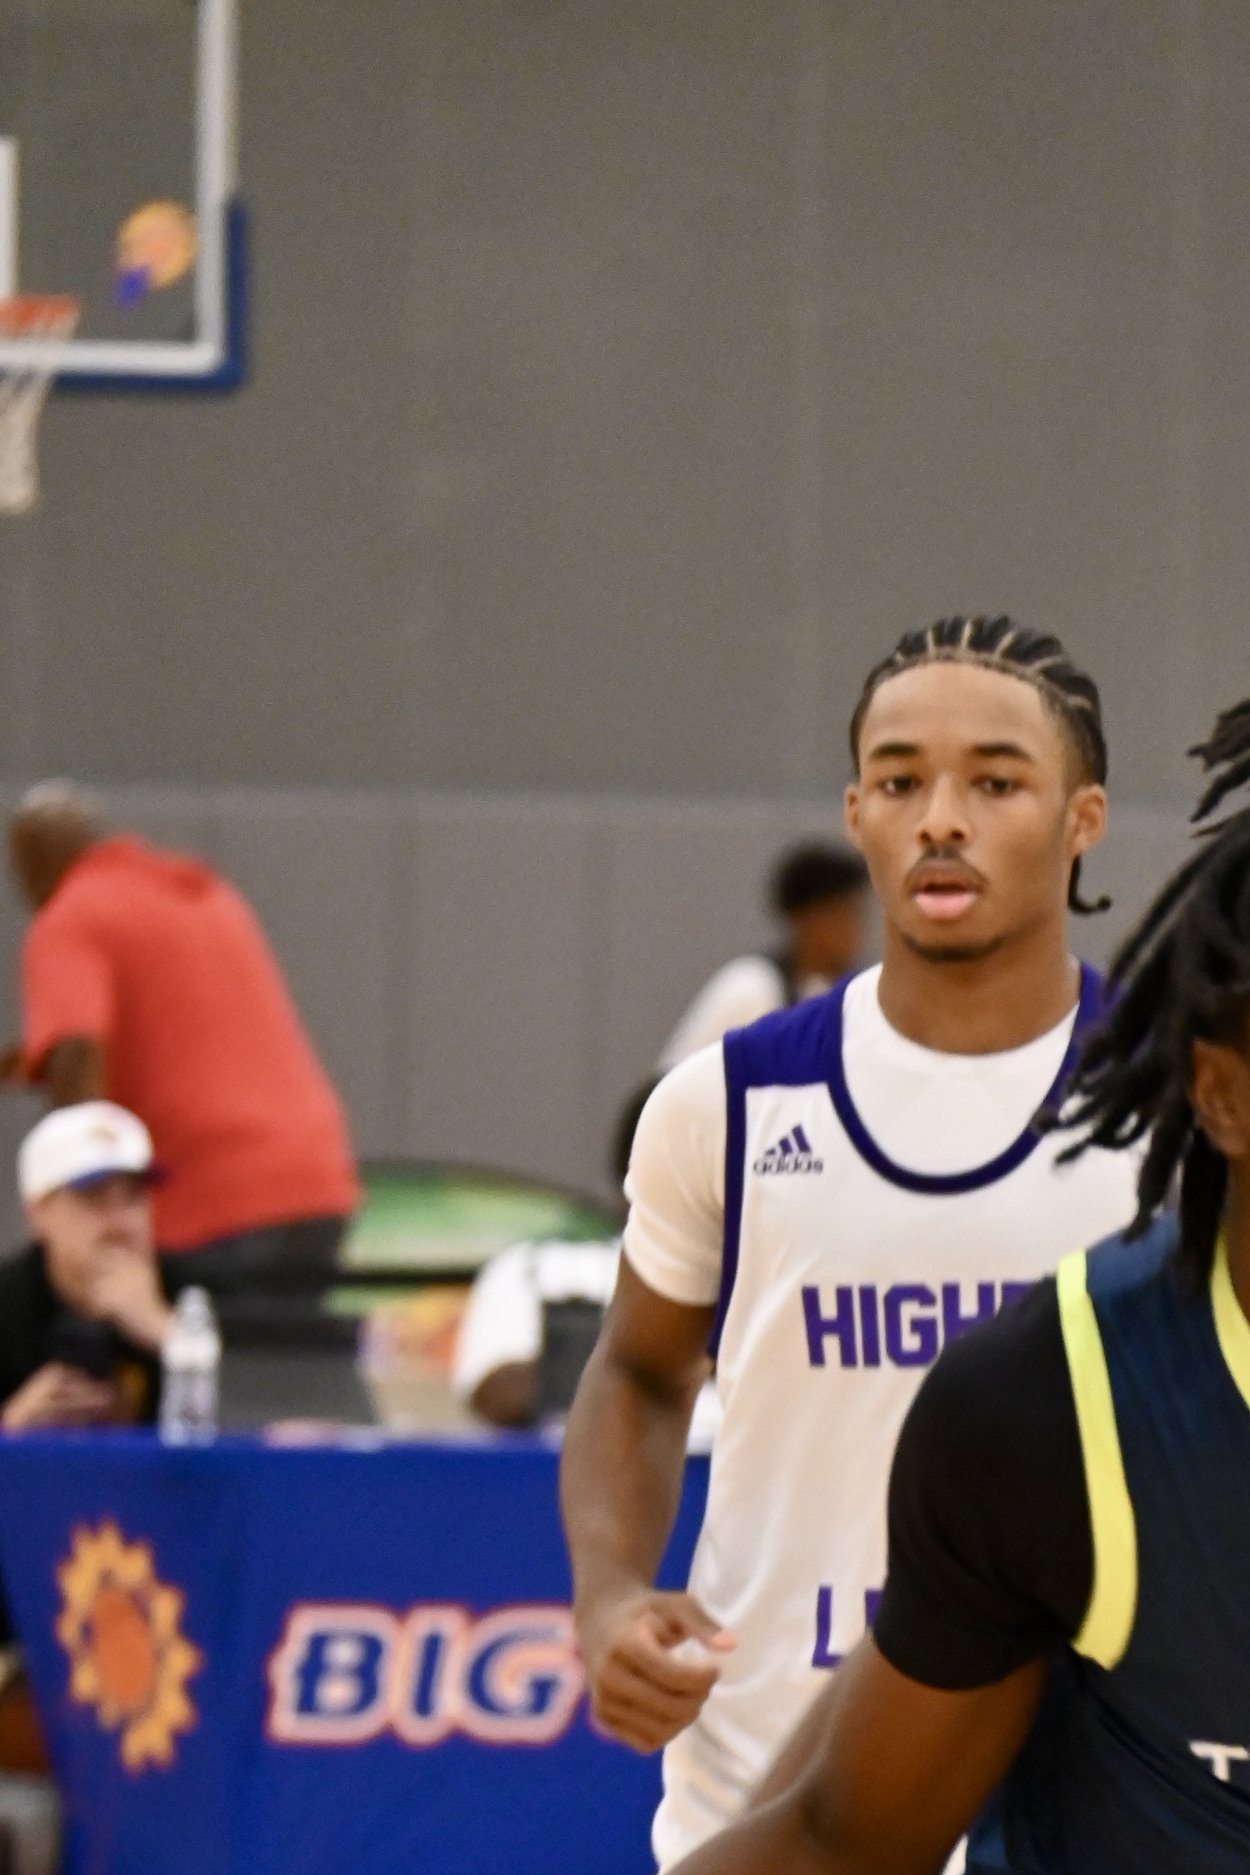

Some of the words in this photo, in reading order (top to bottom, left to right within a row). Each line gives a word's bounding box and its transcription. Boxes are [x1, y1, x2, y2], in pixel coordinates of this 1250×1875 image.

[753, 1155, 823, 1175] adidas
[801, 1281, 1038, 1369] HIGH
[269, 1606, 584, 1743] BIG
